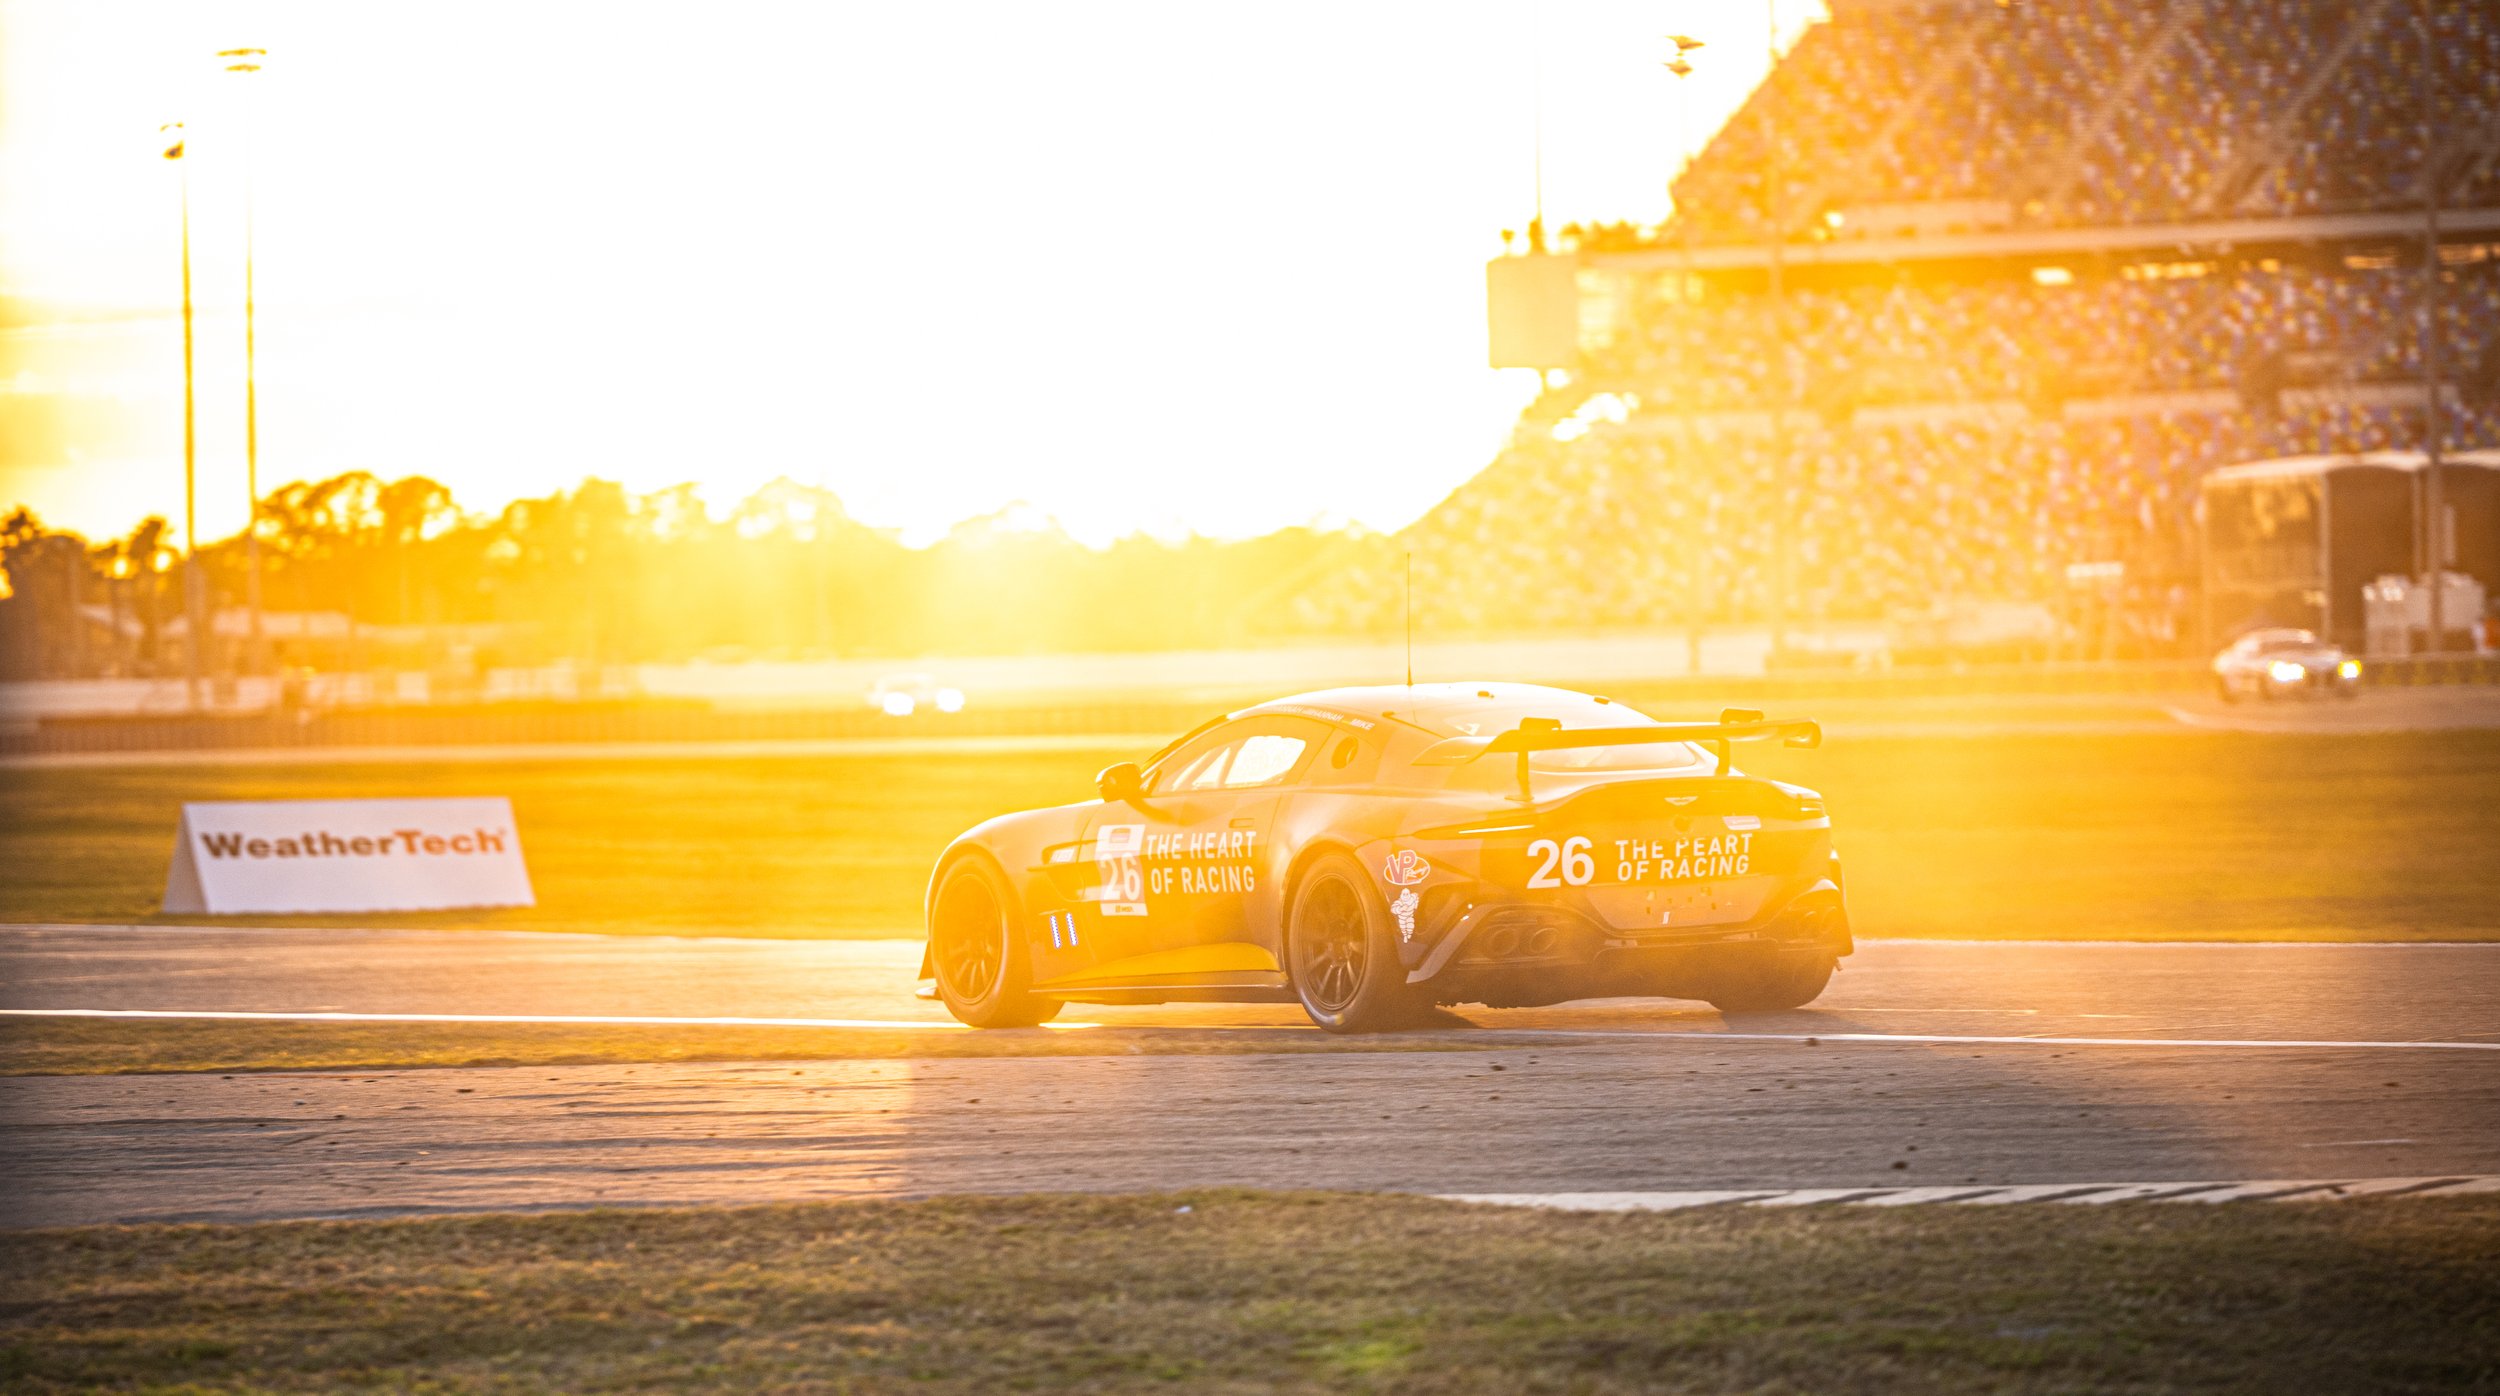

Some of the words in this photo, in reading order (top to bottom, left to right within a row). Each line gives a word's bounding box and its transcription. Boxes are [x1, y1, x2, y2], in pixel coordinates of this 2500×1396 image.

[201, 828, 504, 858] WeatherTech
[1147, 834, 1183, 860] THE
[1190, 831, 1257, 859] HEART
[1615, 839, 1664, 861] THE
[1100, 852, 1141, 901] 26
[1386, 849, 1417, 884] VP
[1527, 836, 1595, 889] 26
[1617, 860, 1650, 881] OF
[1659, 855, 1750, 880] RACING
[1151, 867, 1174, 894] OF
[1181, 865, 1255, 893] RACING
